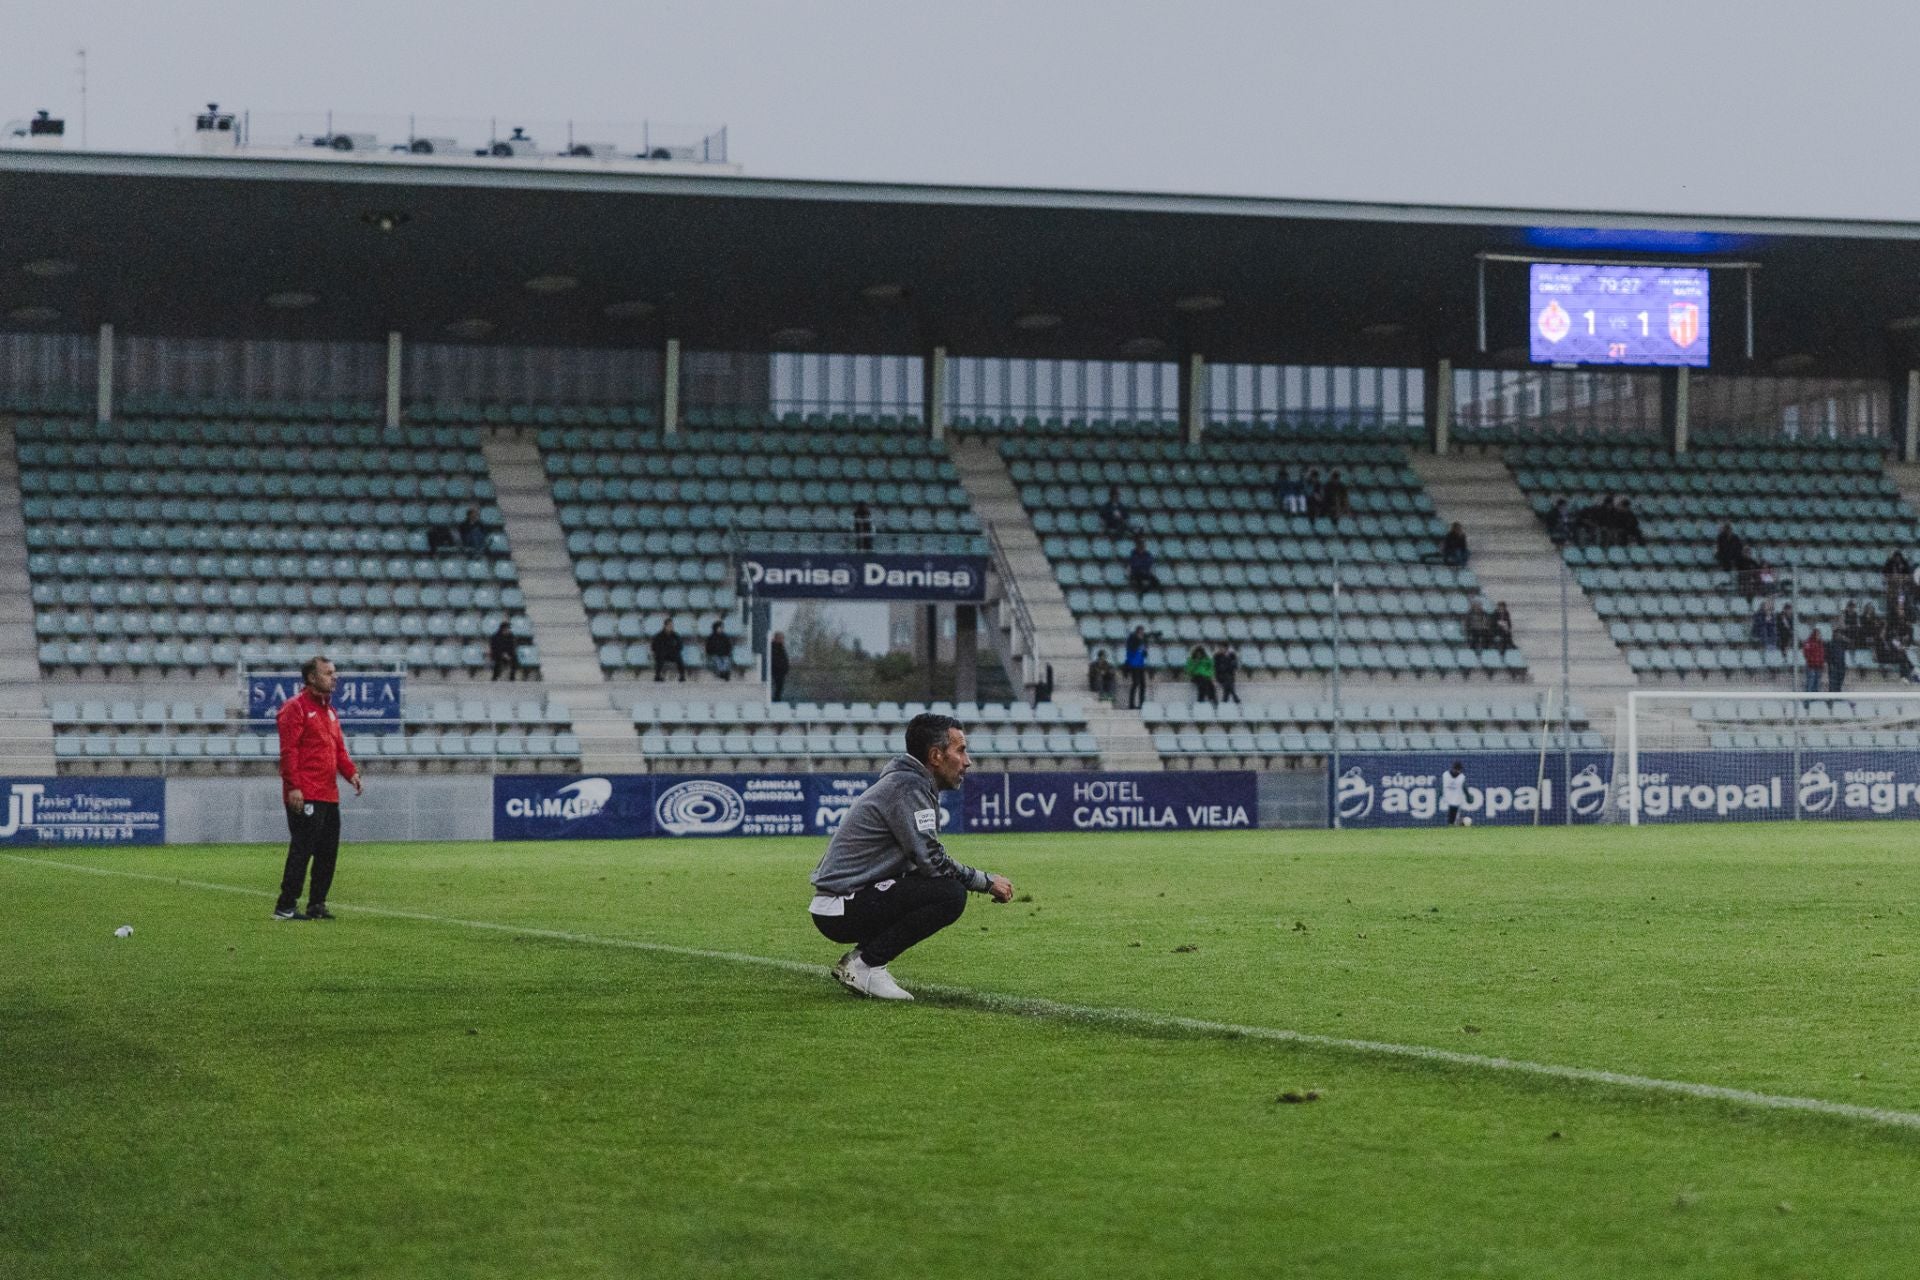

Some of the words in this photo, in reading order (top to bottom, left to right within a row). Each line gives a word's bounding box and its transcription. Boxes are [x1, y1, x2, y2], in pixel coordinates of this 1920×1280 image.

[1583, 309, 1595, 336] 1
[1637, 311, 1649, 337] 1
[1608, 343, 1628, 358] 2T
[742, 561, 850, 586] Danisa
[864, 562, 971, 587] Danisa
[1382, 772, 1437, 788] súper
[1617, 770, 1669, 786] sper
[1844, 768, 1896, 784] súper
[37, 793, 72, 808] Javier
[75, 793, 132, 810] Trigueros
[1073, 782, 1144, 802] HOTEL
[1382, 778, 1552, 819] agopal
[1617, 776, 1782, 816] agropal
[1844, 782, 1920, 814] agr
[1073, 806, 1178, 828] CASTILLA
[1187, 805, 1249, 827] VIEJA
